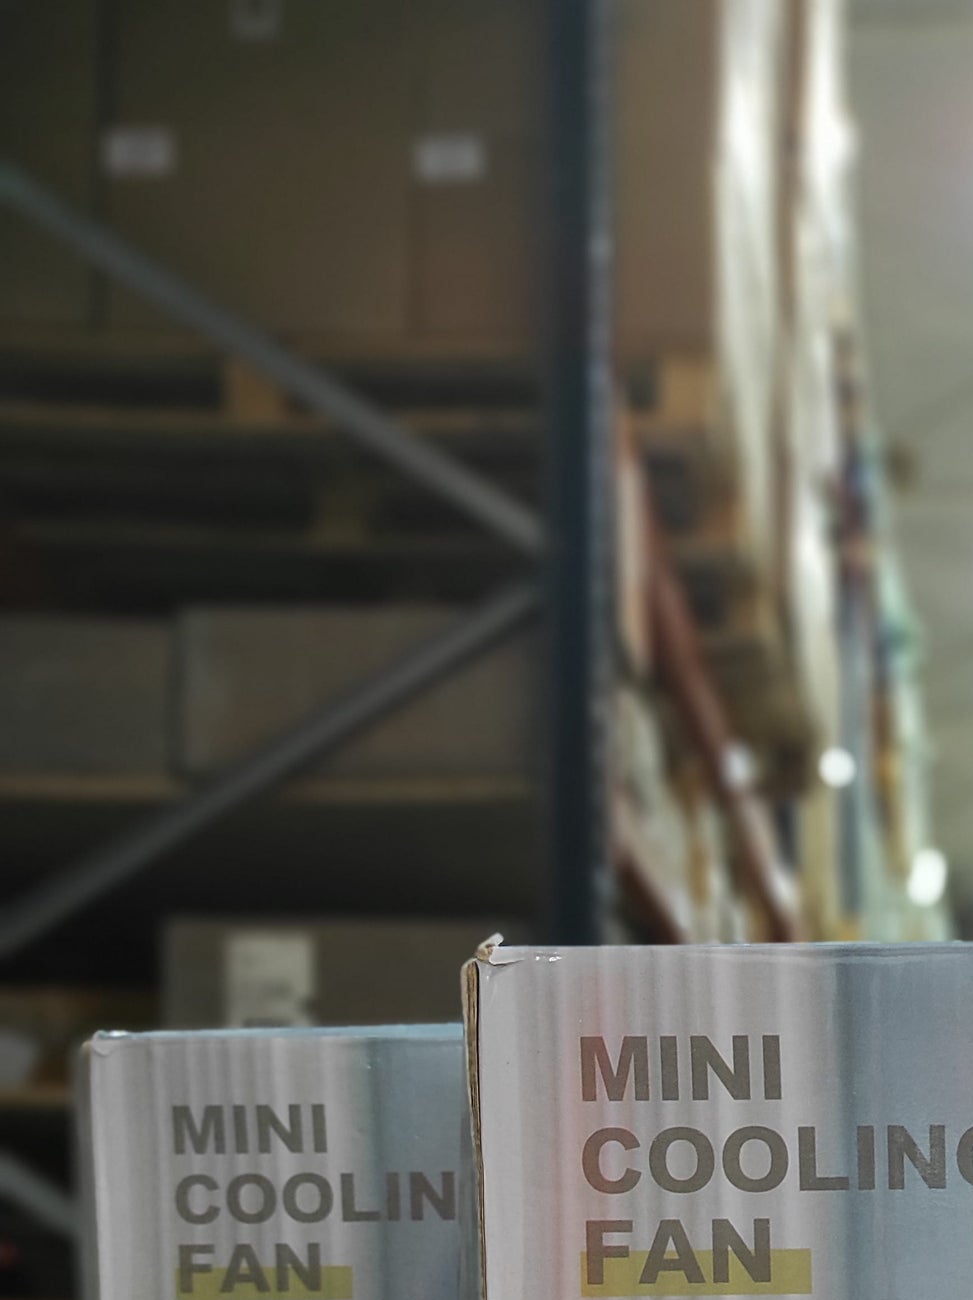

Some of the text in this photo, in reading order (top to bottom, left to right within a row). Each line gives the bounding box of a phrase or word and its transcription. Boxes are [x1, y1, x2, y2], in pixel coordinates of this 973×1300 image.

[580, 1035, 783, 1102] MINI
[172, 1103, 328, 1155] MINI
[178, 1242, 323, 1294] FAN
[585, 1218, 772, 1285] FAN
